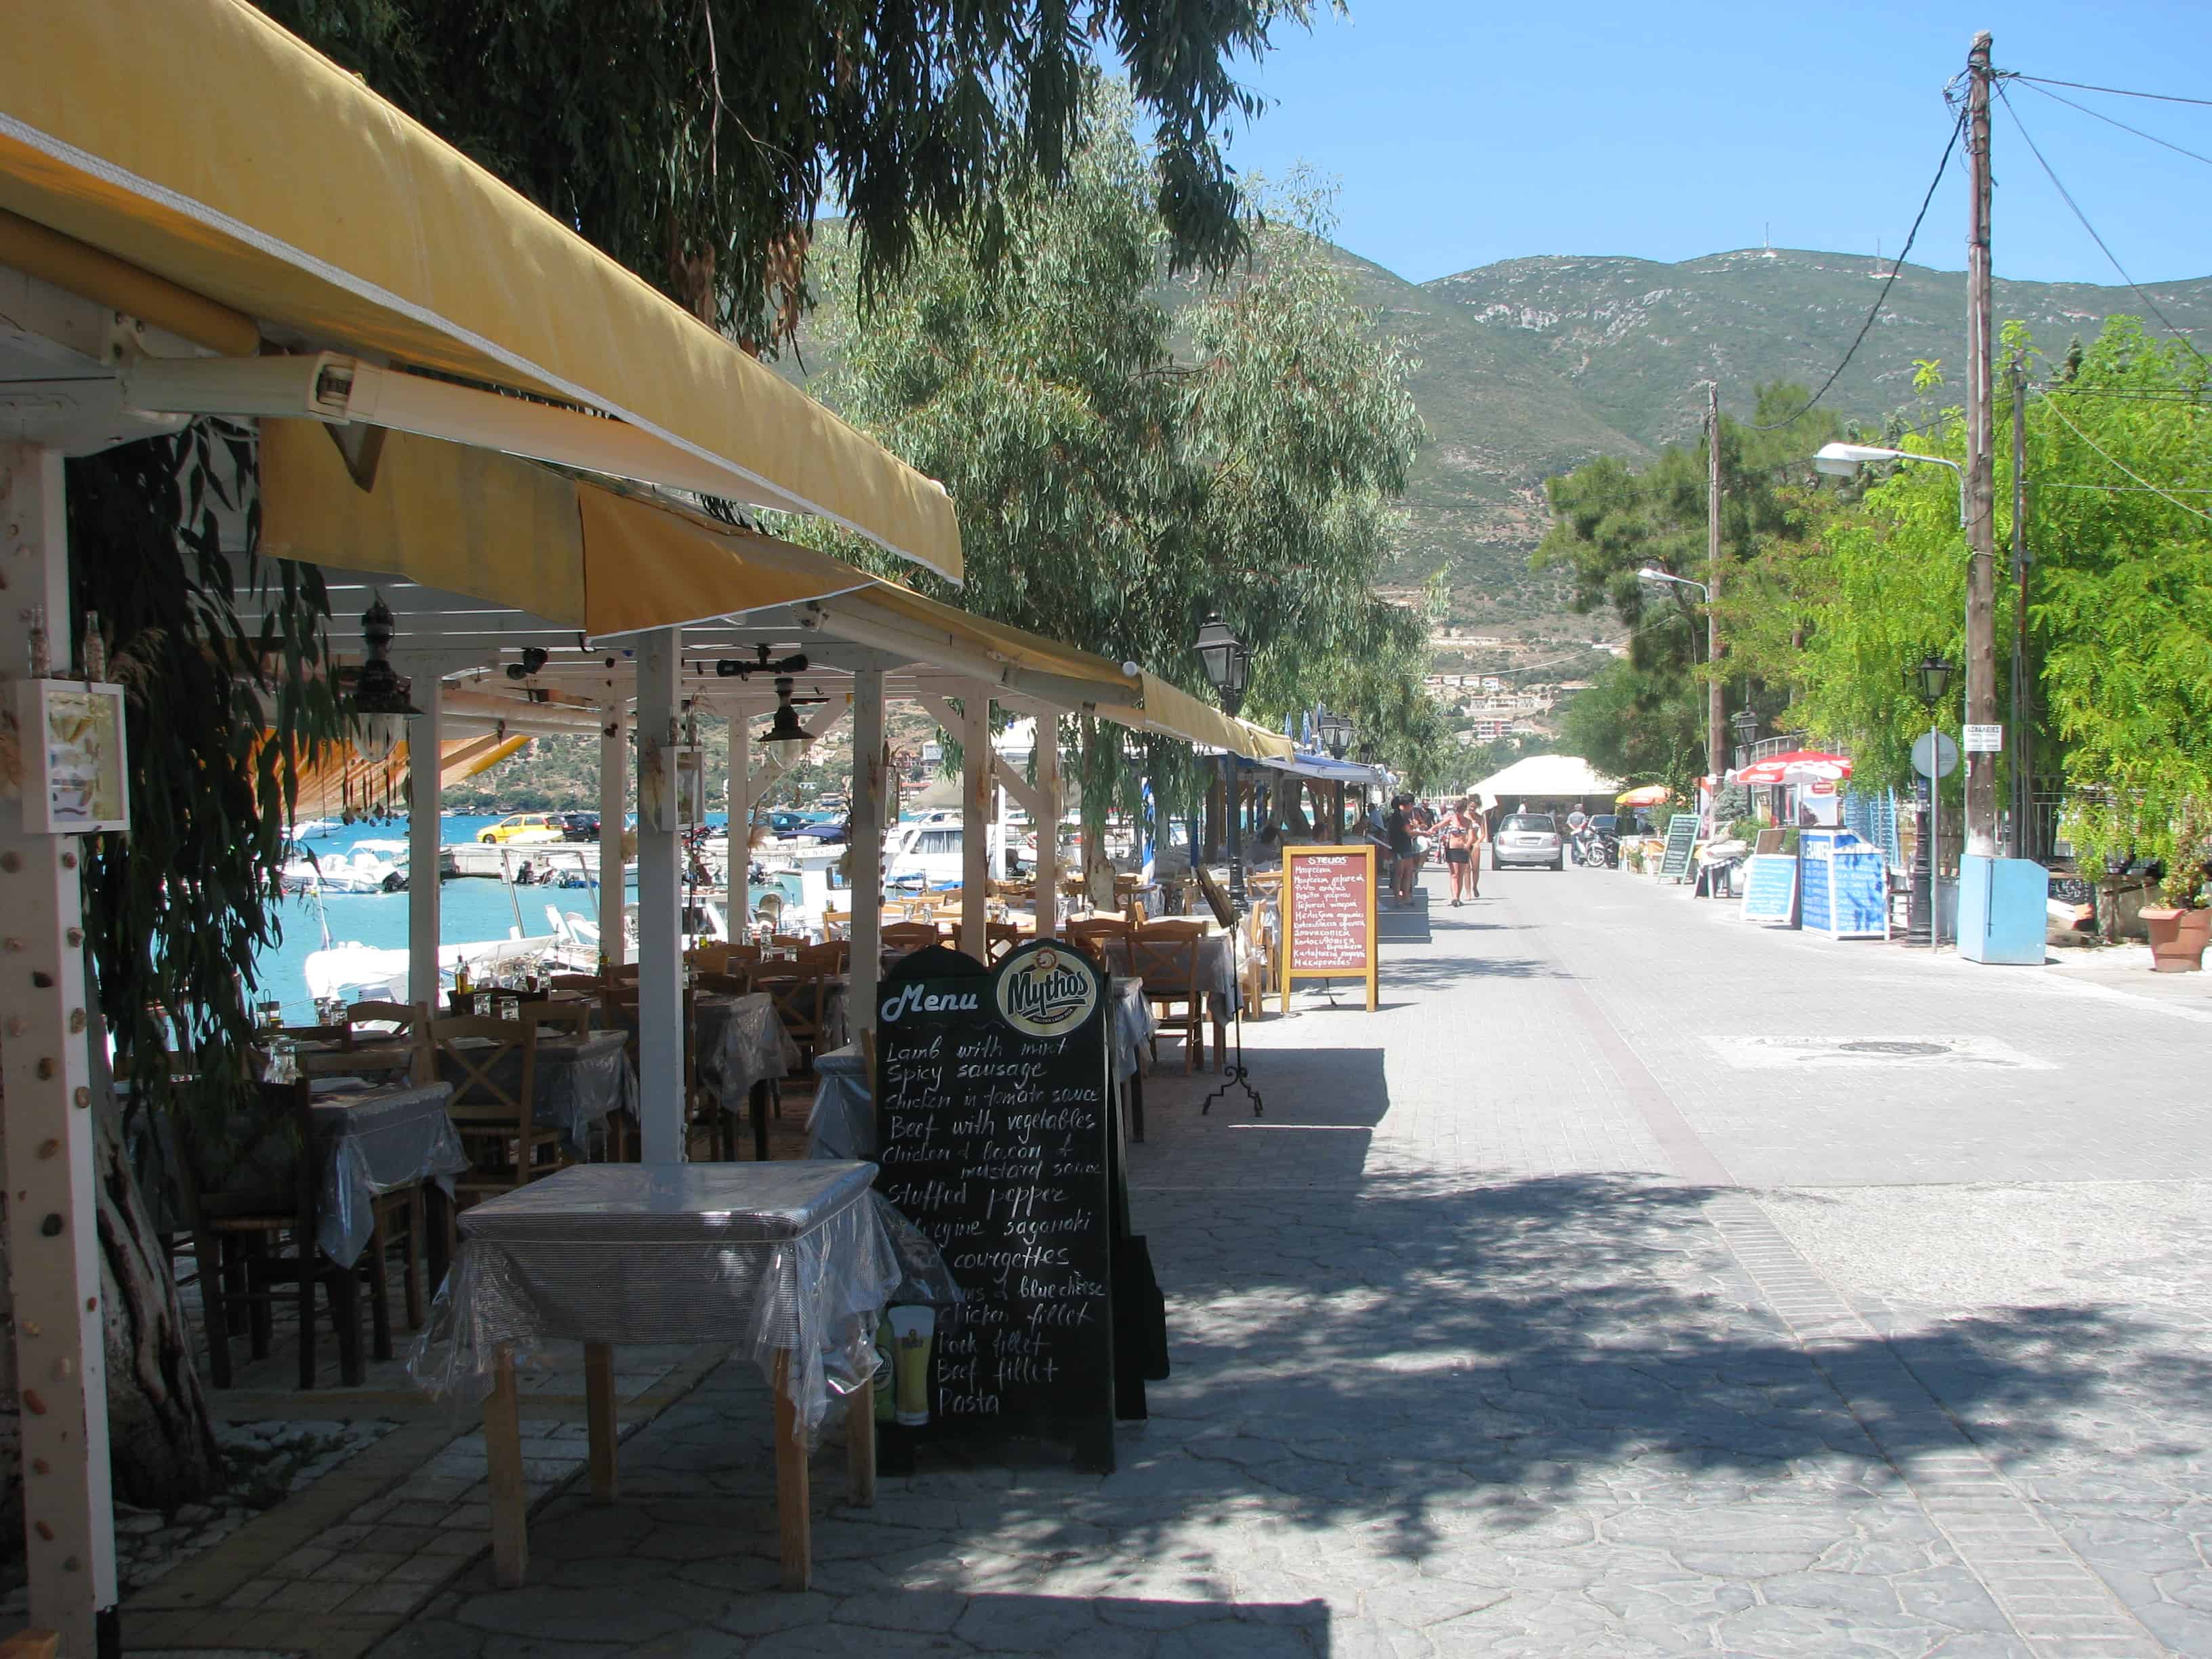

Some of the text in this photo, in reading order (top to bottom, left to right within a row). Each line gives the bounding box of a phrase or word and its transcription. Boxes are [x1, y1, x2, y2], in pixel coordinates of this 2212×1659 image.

[881, 983, 979, 1022] Menu
[1007, 969, 1090, 1017] Mythos
[886, 1035, 1068, 1063] Lamb with mint
[887, 1062, 1046, 1094] Spicy sausage
[964, 1088, 977, 1106] in
[890, 1108, 1096, 1148] Beef with vegetables
[984, 1144, 1042, 1161] bacon
[960, 1160, 1042, 1181] mustard
[888, 1182, 1069, 1218] Stuffed pepper
[1004, 1209, 1093, 1244] saganaki
[954, 1246, 1069, 1284] courgettes
[1020, 1275, 1059, 1298] blue
[937, 1302, 1094, 1336] Chicken fillet
[938, 1330, 977, 1355] Pork
[992, 1328, 1051, 1358] fillet
[937, 1356, 1059, 1391] Beef fillet
[938, 1387, 1000, 1416] Pasta
